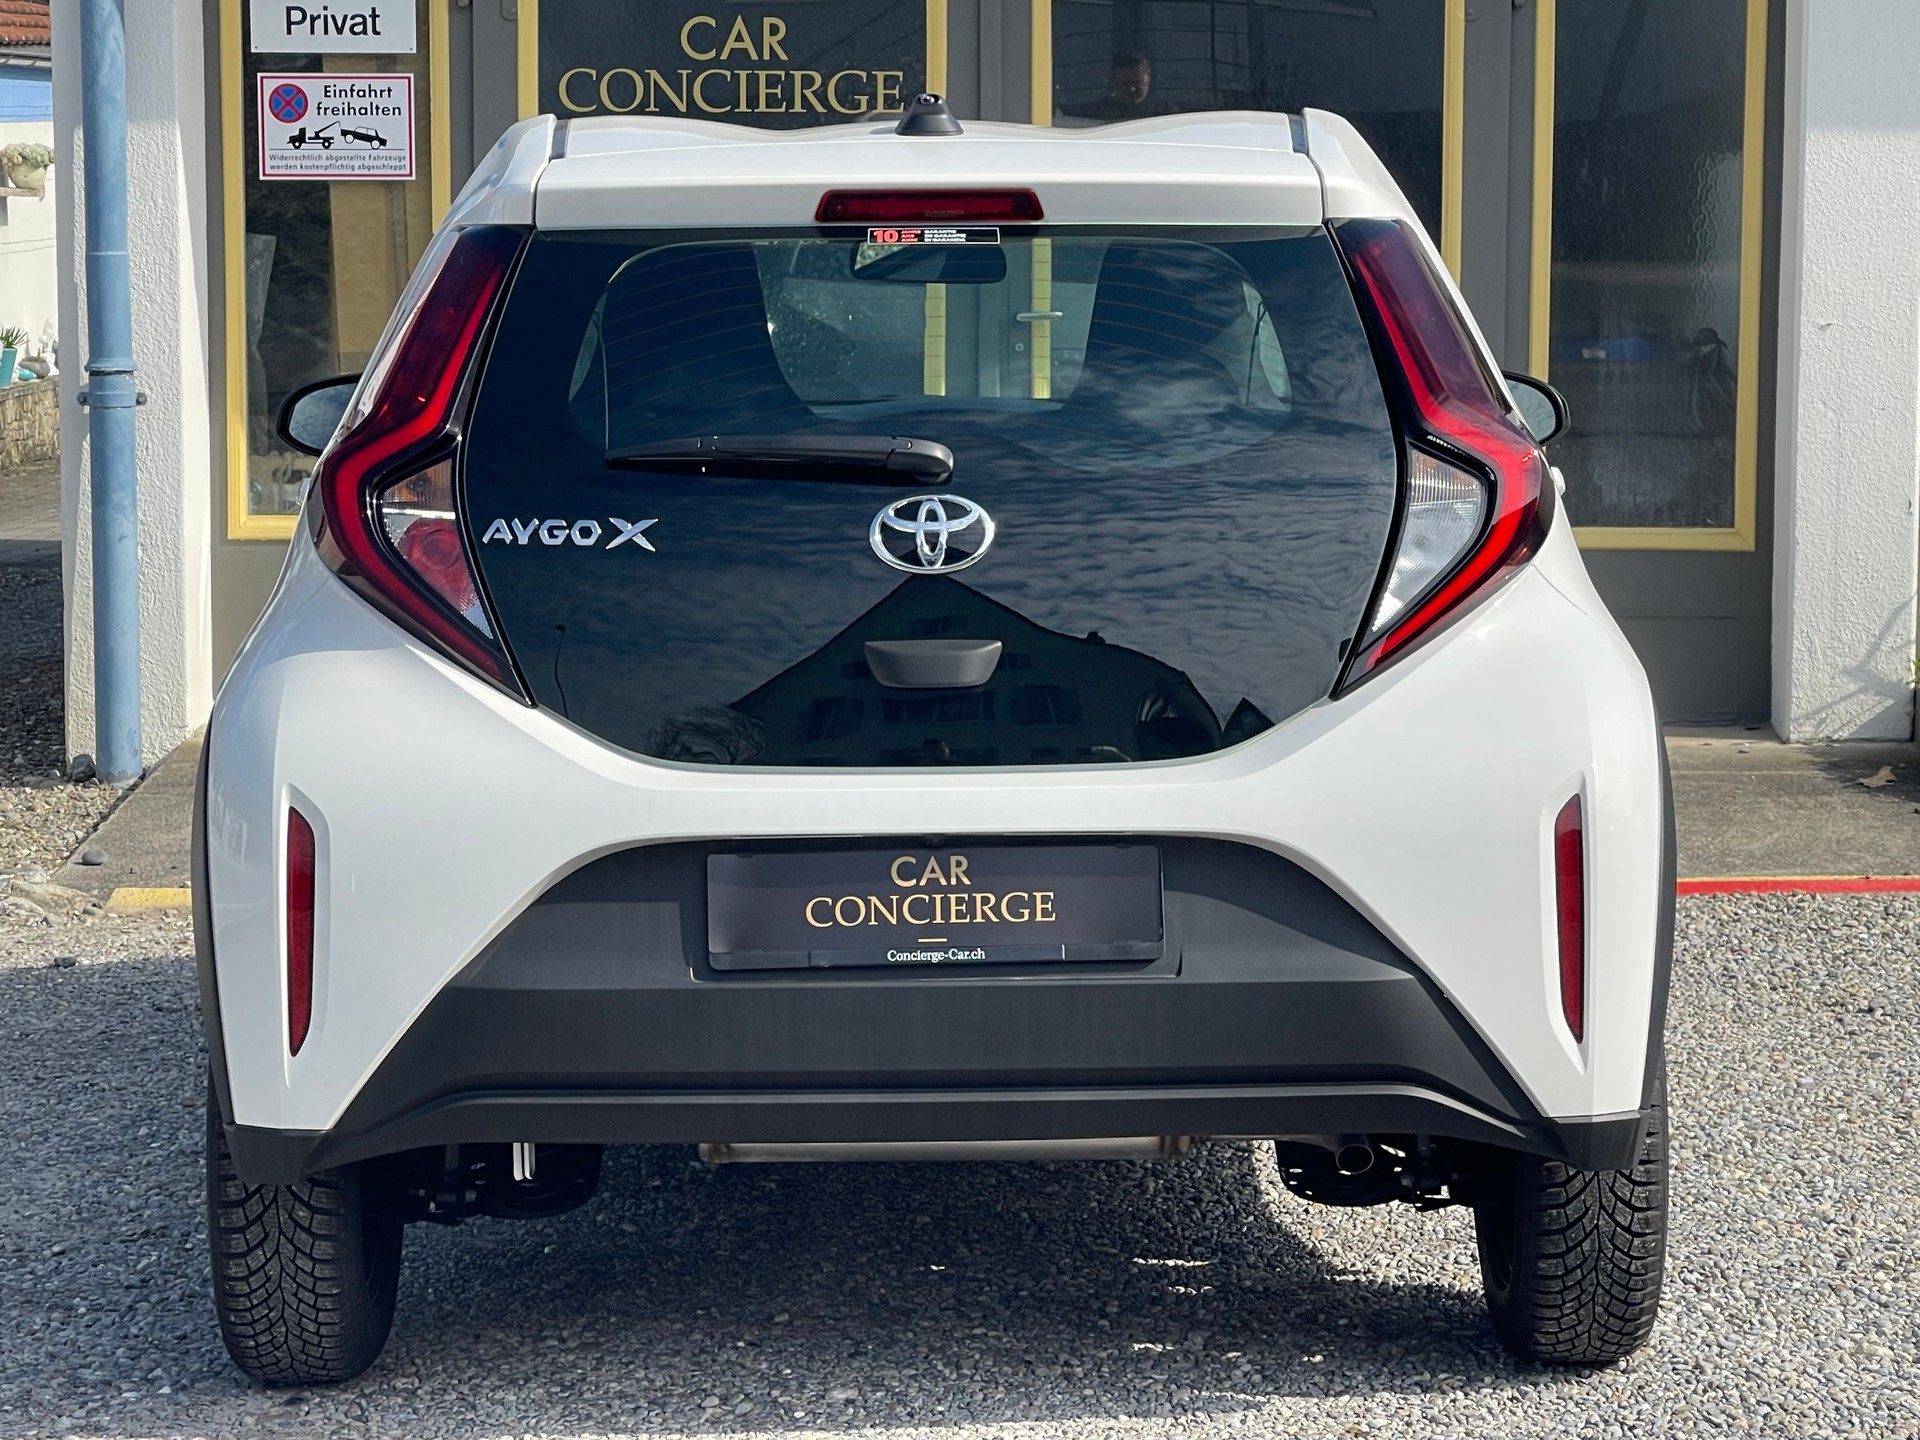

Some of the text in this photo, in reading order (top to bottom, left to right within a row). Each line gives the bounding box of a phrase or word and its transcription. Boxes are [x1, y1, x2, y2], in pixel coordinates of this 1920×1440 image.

[285, 5, 382, 36] Privat
[680, 14, 789, 61] CAR
[323, 84, 393, 98] Einfahrt
[558, 67, 904, 114] CONCIERGE
[316, 102, 402, 116] freihalten
[299, 163, 356, 171] kostenpflichtig
[357, 163, 407, 171] abgeschleppt
[325, 154, 366, 163] abgestellte
[368, 154, 407, 163] Fahrzeuge
[873, 229, 899, 243] 10
[482, 516, 659, 552] AYGO X
[890, 855, 972, 887] CAR
[805, 891, 1057, 928] CONCIERGE
[887, 947, 986, 964] Concierge-Car.ch
